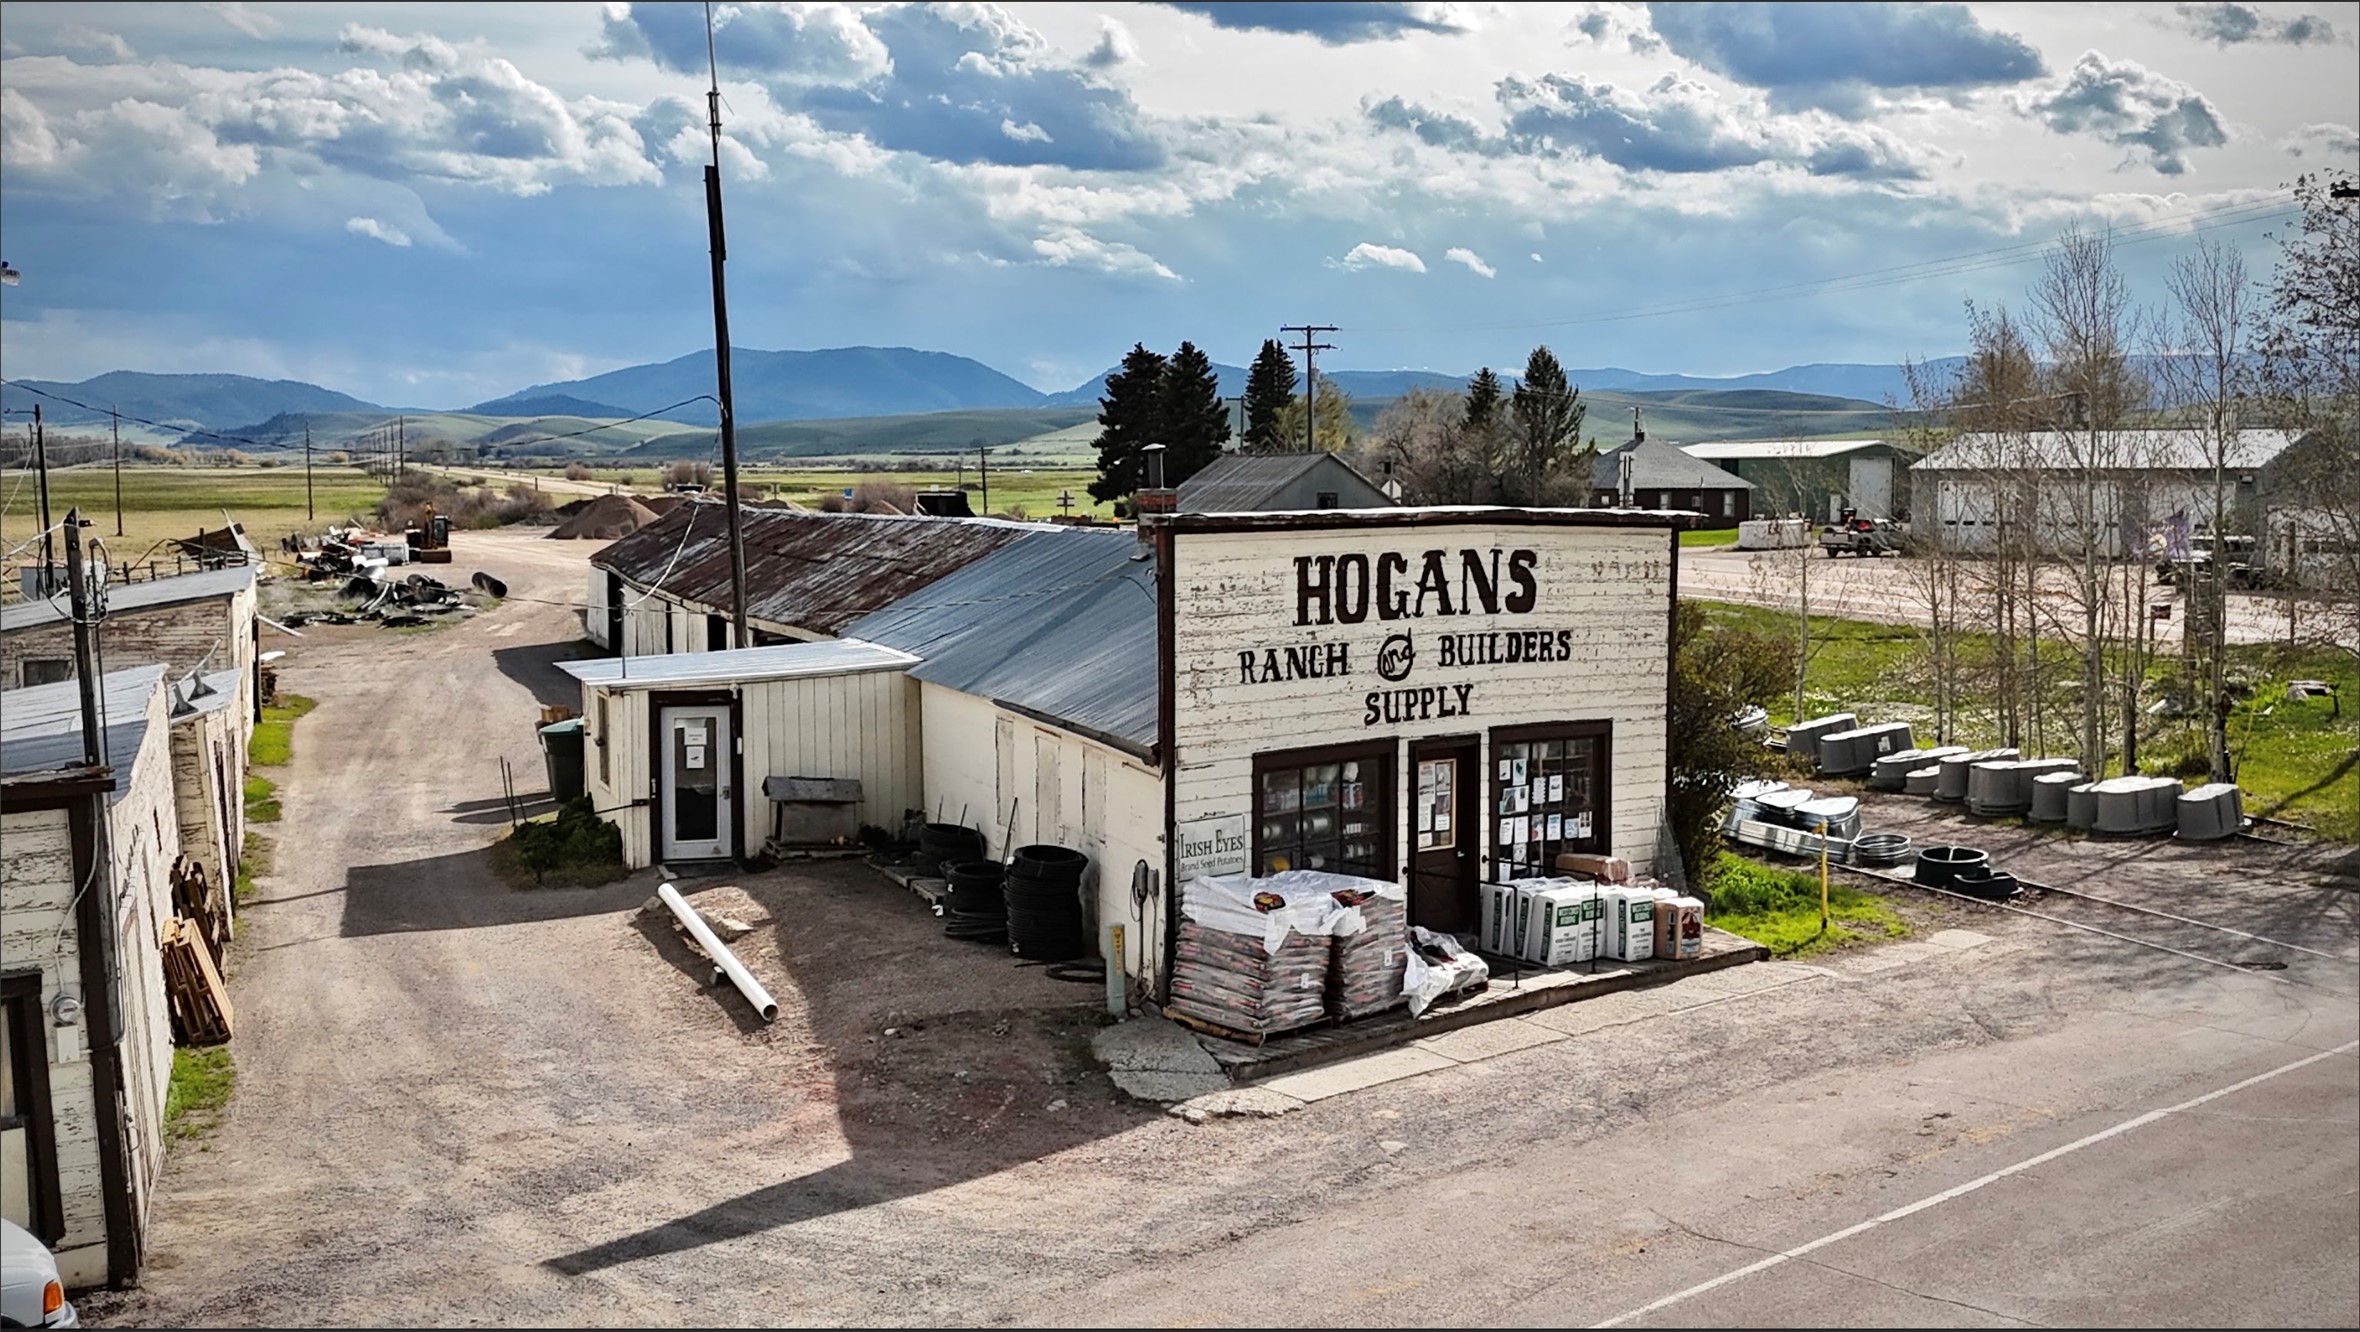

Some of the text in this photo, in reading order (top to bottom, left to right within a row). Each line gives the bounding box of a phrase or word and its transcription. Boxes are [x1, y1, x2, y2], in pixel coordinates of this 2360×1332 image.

[1293, 549, 1537, 626] HOGANS
[1238, 627, 1572, 684] RANCH and BUILDERS
[1364, 684, 1473, 725] SUPPLY
[1180, 829, 1243, 858] IRISH EYES
